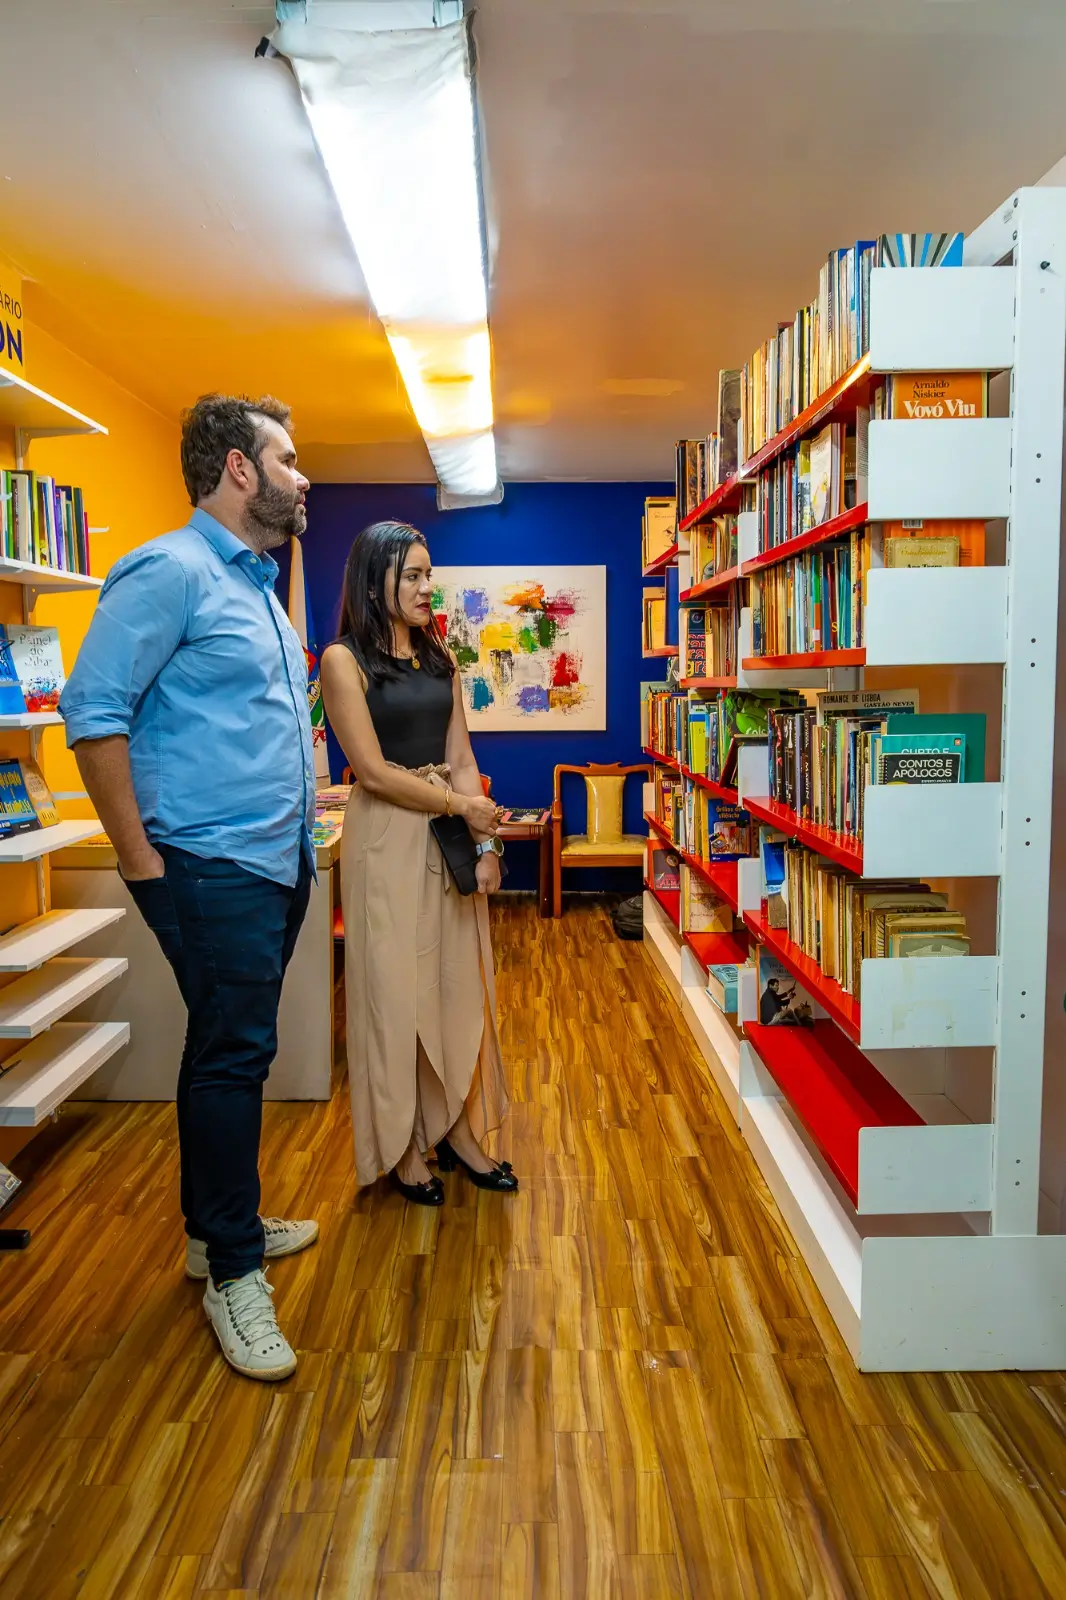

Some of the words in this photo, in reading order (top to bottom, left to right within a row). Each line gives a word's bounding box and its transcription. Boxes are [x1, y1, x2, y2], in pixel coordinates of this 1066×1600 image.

[913, 379, 949, 390] Arnaldo
[913, 390, 946, 399] Niskier
[903, 399, 943, 418] Vovó
[944, 398, 976, 417] Viu
[823, 694, 849, 704] ROMANCE
[852, 694, 859, 703] DE
[861, 693, 881, 703] LISBOA
[898, 759, 944, 768] CONTOS
[945, 760, 953, 768] E
[892, 768, 953, 778] APÓLOGOS
